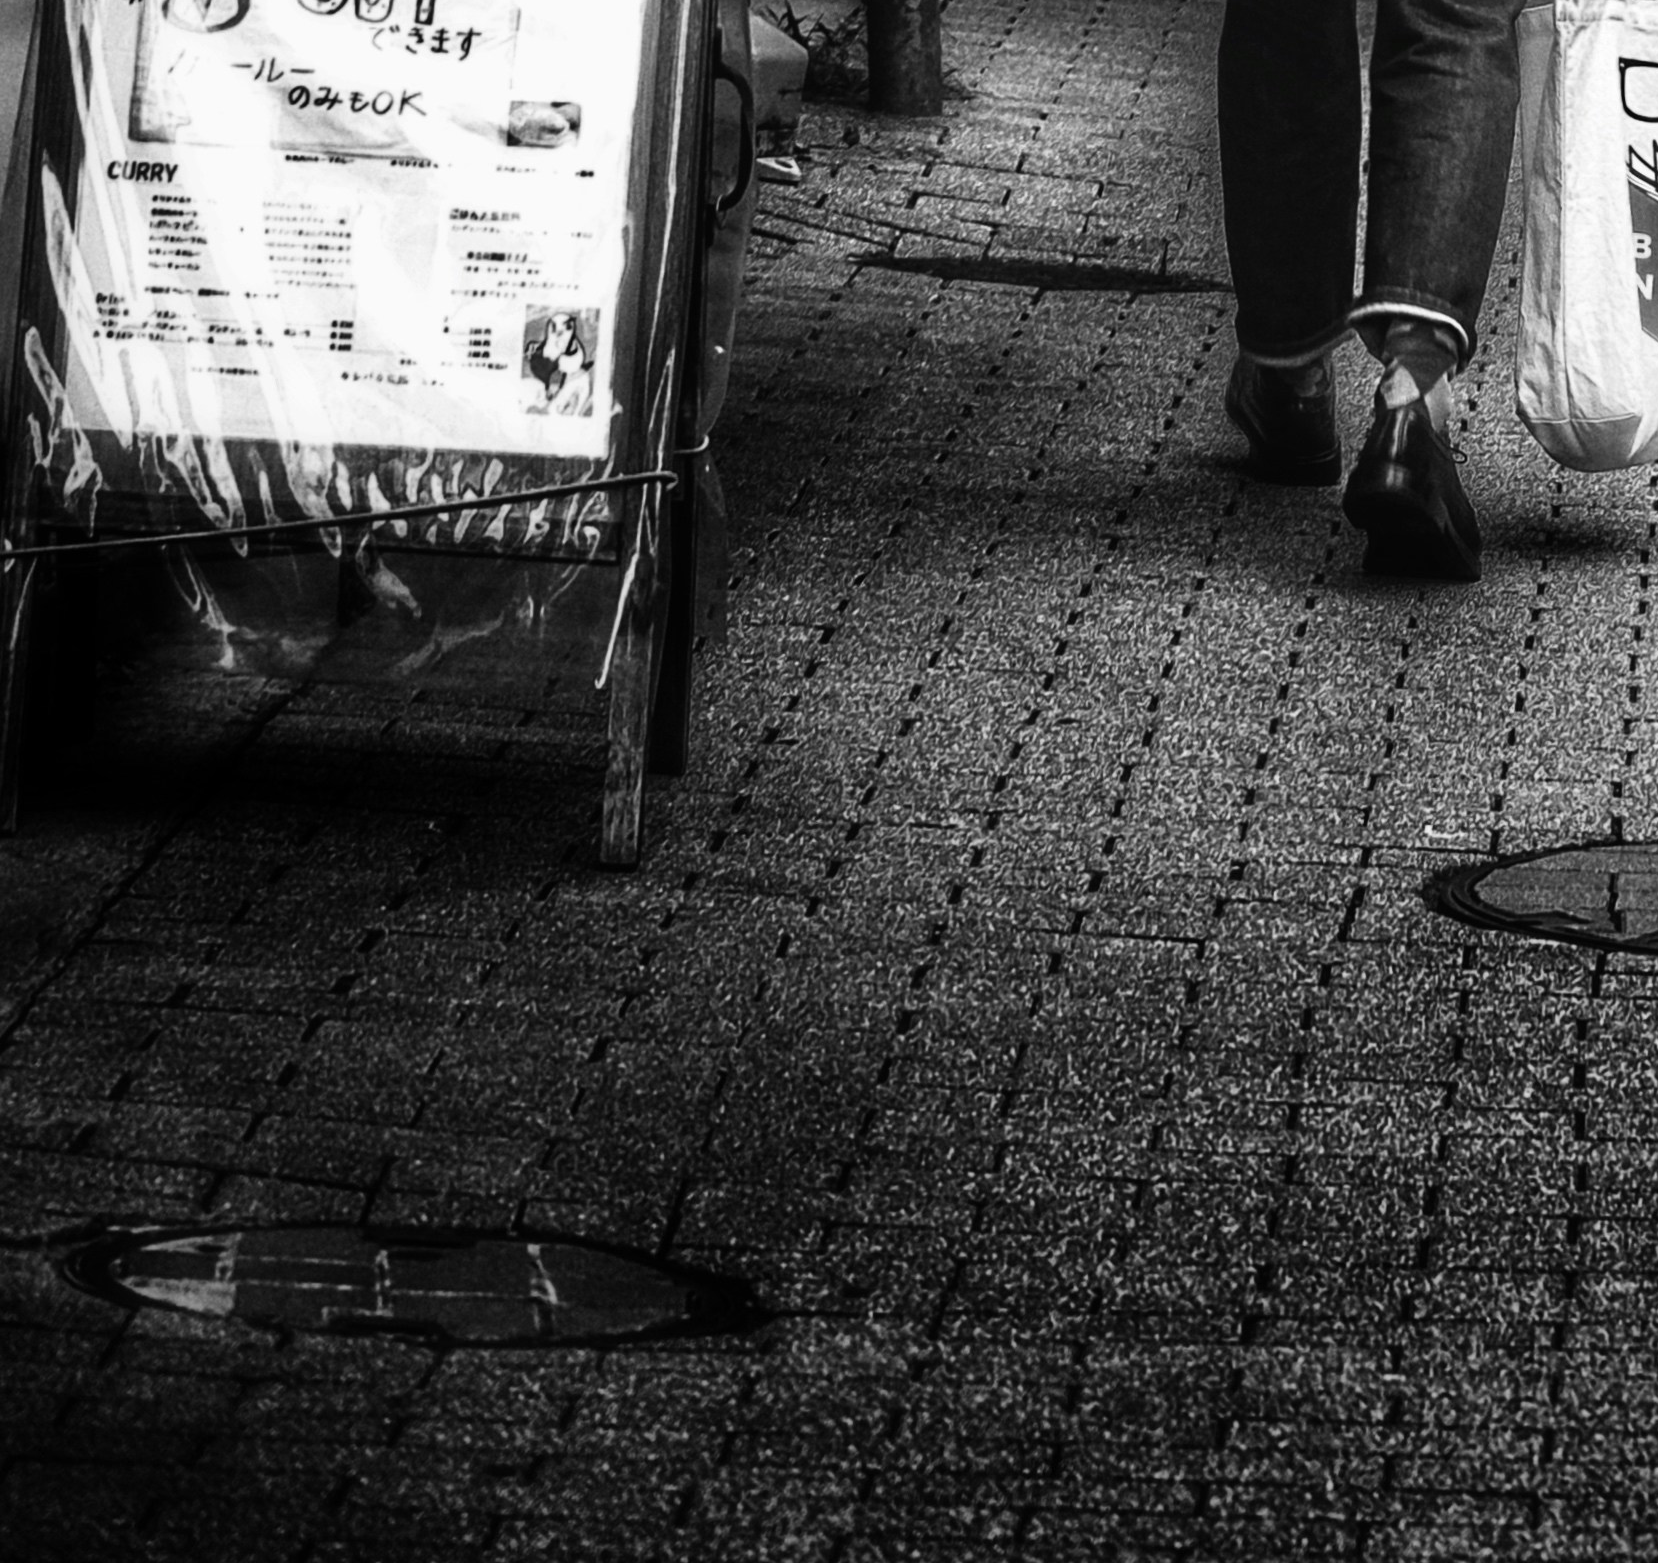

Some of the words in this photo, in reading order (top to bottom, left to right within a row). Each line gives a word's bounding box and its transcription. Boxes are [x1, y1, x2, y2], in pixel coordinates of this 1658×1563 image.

[369, 24, 483, 61] できます
[107, 160, 179, 183] CURRY
